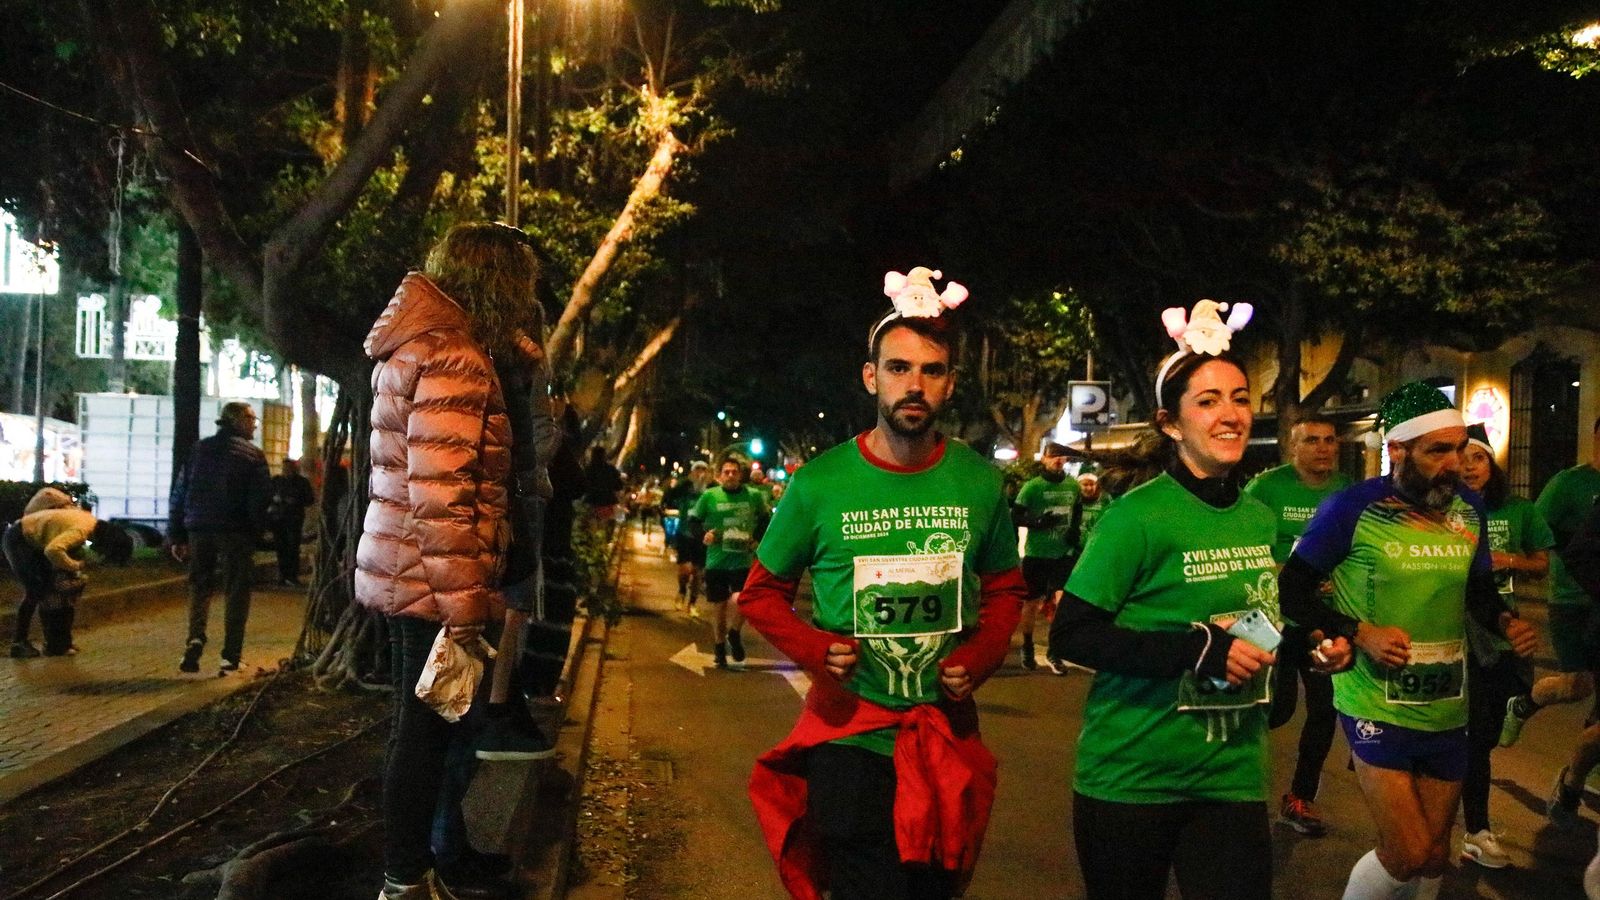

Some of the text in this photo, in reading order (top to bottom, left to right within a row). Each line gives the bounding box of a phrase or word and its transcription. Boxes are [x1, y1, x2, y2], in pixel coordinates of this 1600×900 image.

[1072, 385, 1106, 424] P
[842, 506, 969, 523] XVII SAN SILVESTRE
[842, 517, 969, 535] CIUDAD DE ALMERÍA
[1183, 551, 1208, 563] XVII
[1209, 548, 1231, 560] SAN
[1409, 545, 1471, 557] SAKATA
[1184, 562, 1228, 576] CIUDAD
[1230, 560, 1244, 571] DE
[874, 595, 943, 625] 579
[1402, 671, 1453, 694] 952
